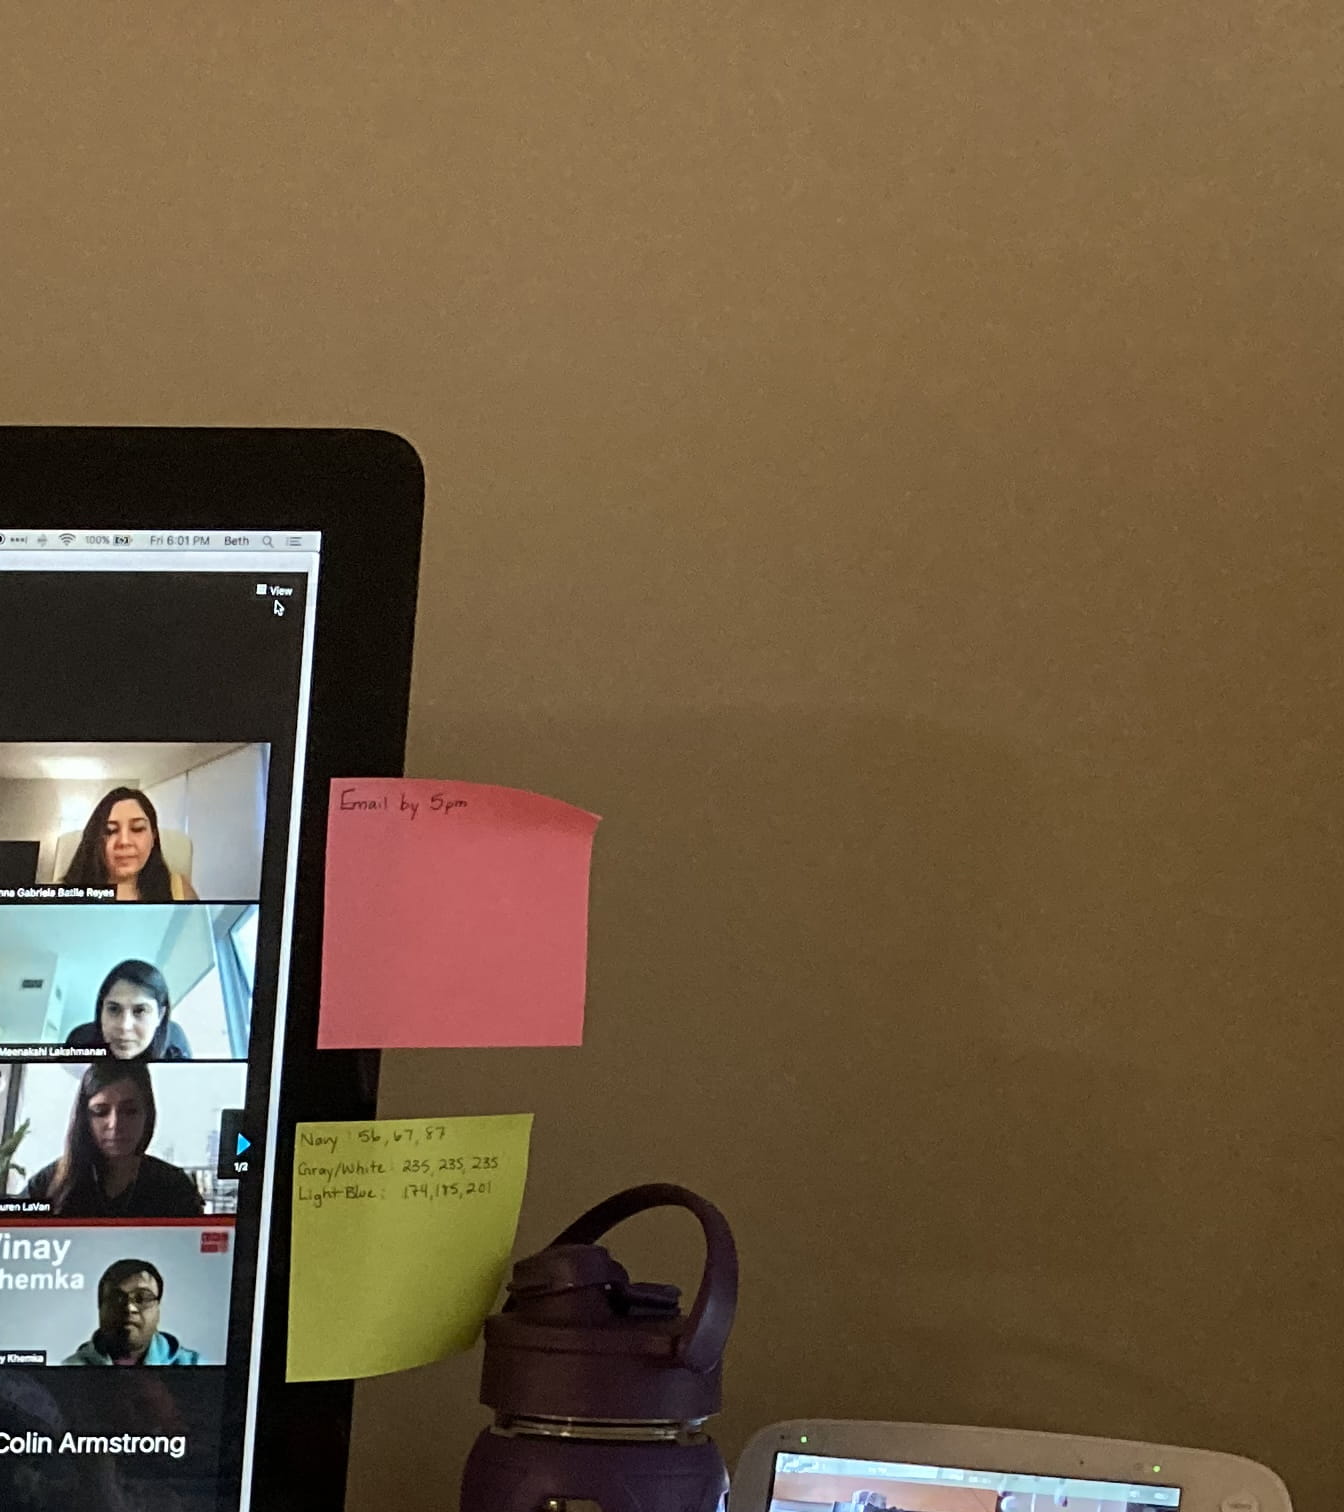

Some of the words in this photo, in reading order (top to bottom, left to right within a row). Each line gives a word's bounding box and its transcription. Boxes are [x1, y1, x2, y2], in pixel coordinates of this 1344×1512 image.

[149, 534, 163, 546] Fri
[166, 534, 187, 546] 6:01
[192, 534, 210, 546] PM
[223, 534, 250, 547] Beth
[270, 586, 292, 596] View
[340, 788, 388, 811] Email
[399, 795, 419, 821] by
[429, 793, 469, 815] 5pm
[300, 1132, 339, 1154] Navy
[59, 1432, 185, 1458] Armstrong
